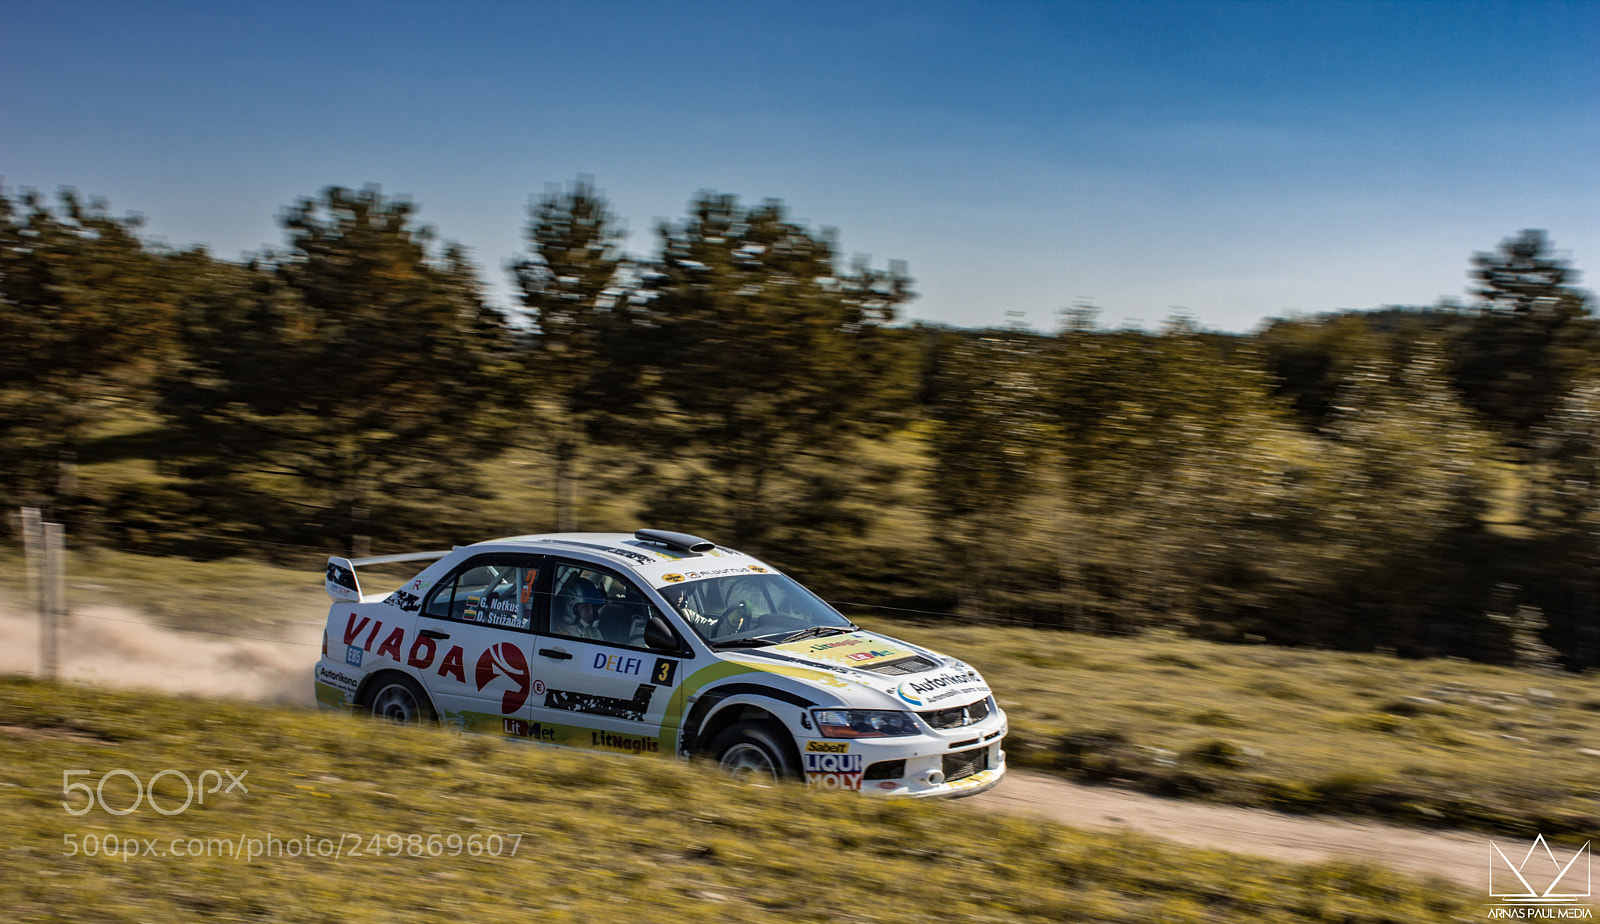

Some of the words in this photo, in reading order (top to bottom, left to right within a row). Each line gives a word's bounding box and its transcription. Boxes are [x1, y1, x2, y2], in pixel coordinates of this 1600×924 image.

[520, 569, 537, 604] 3
[480, 596, 488, 609] G.
[490, 598, 520, 613] Notkus
[476, 610, 485, 623] D.
[343, 612, 467, 684] VIADA
[347, 647, 361, 665] E85
[593, 652, 642, 676] DELFI
[658, 662, 670, 682] 3
[591, 730, 659, 755] LitNaglis
[808, 741, 848, 753] Sabelt
[805, 754, 861, 773] LIQUI
[806, 773, 861, 790] MOLY
